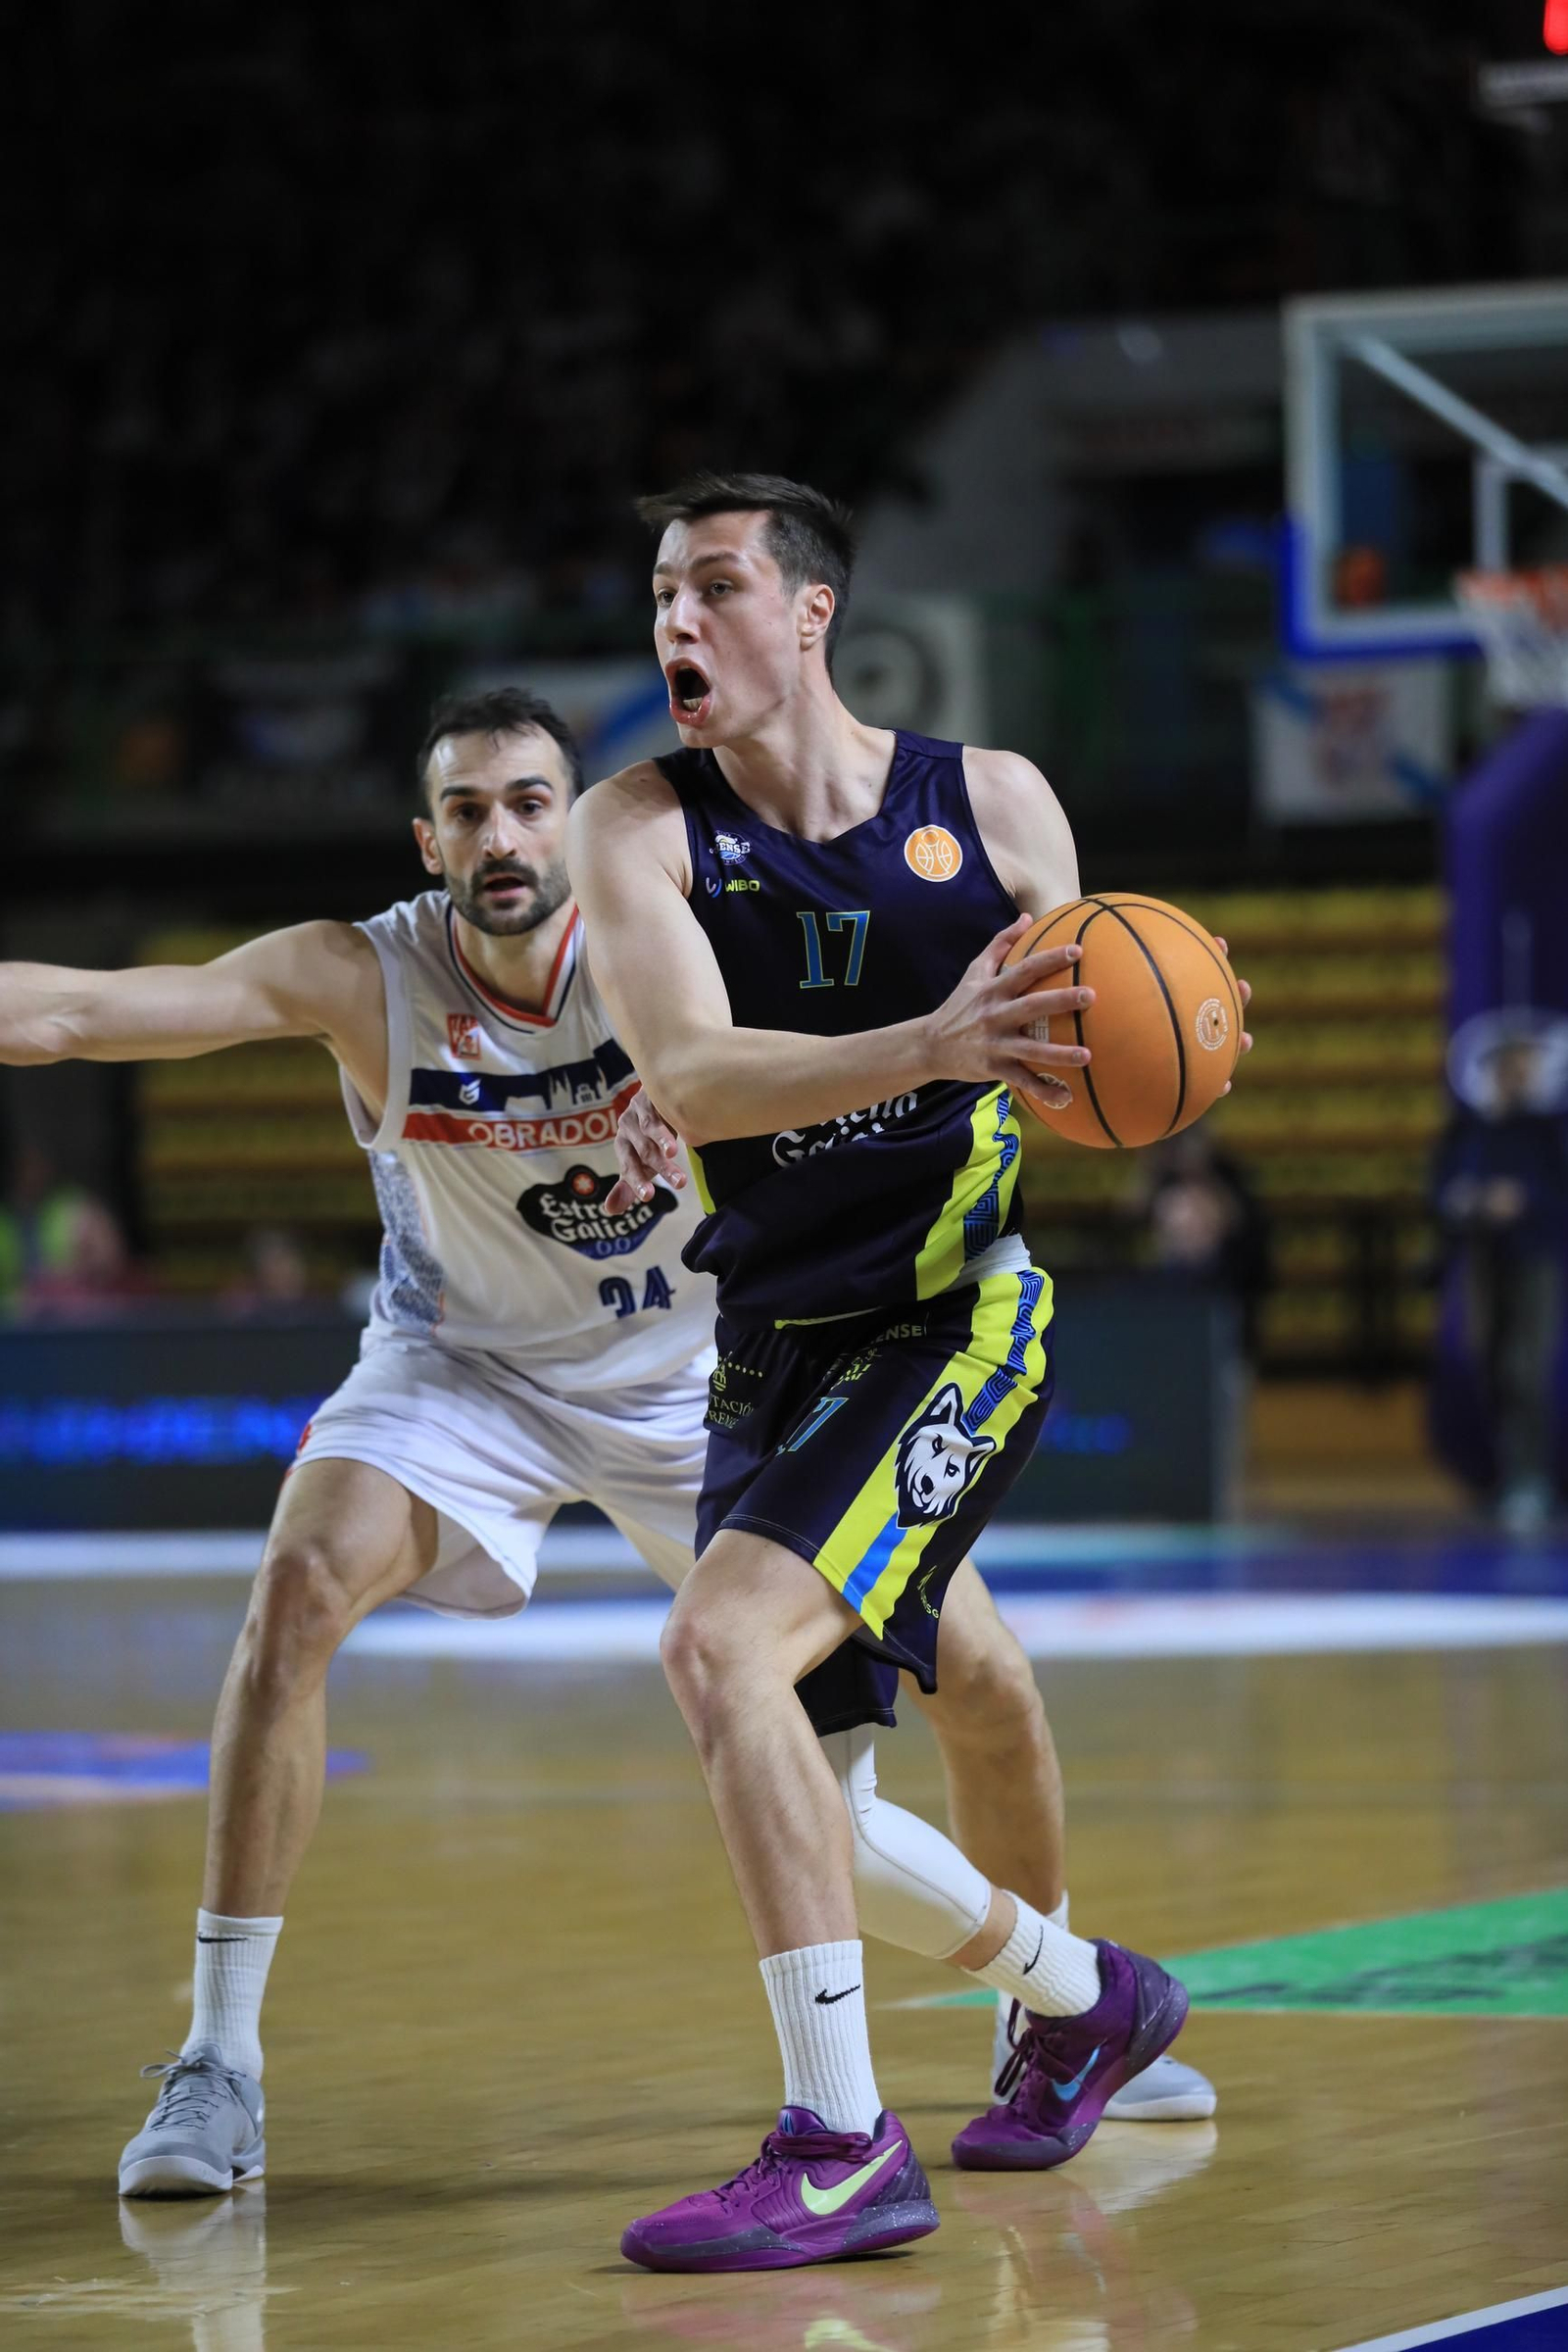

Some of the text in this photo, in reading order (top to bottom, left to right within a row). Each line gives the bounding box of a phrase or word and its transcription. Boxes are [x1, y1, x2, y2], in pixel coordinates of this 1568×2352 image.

[725, 879, 760, 892] WIBO
[796, 909, 871, 989] 17
[467, 1109, 618, 1149] OBRADOI
[550, 1204, 655, 1243] Galicia
[599, 1265, 676, 1319] 24
